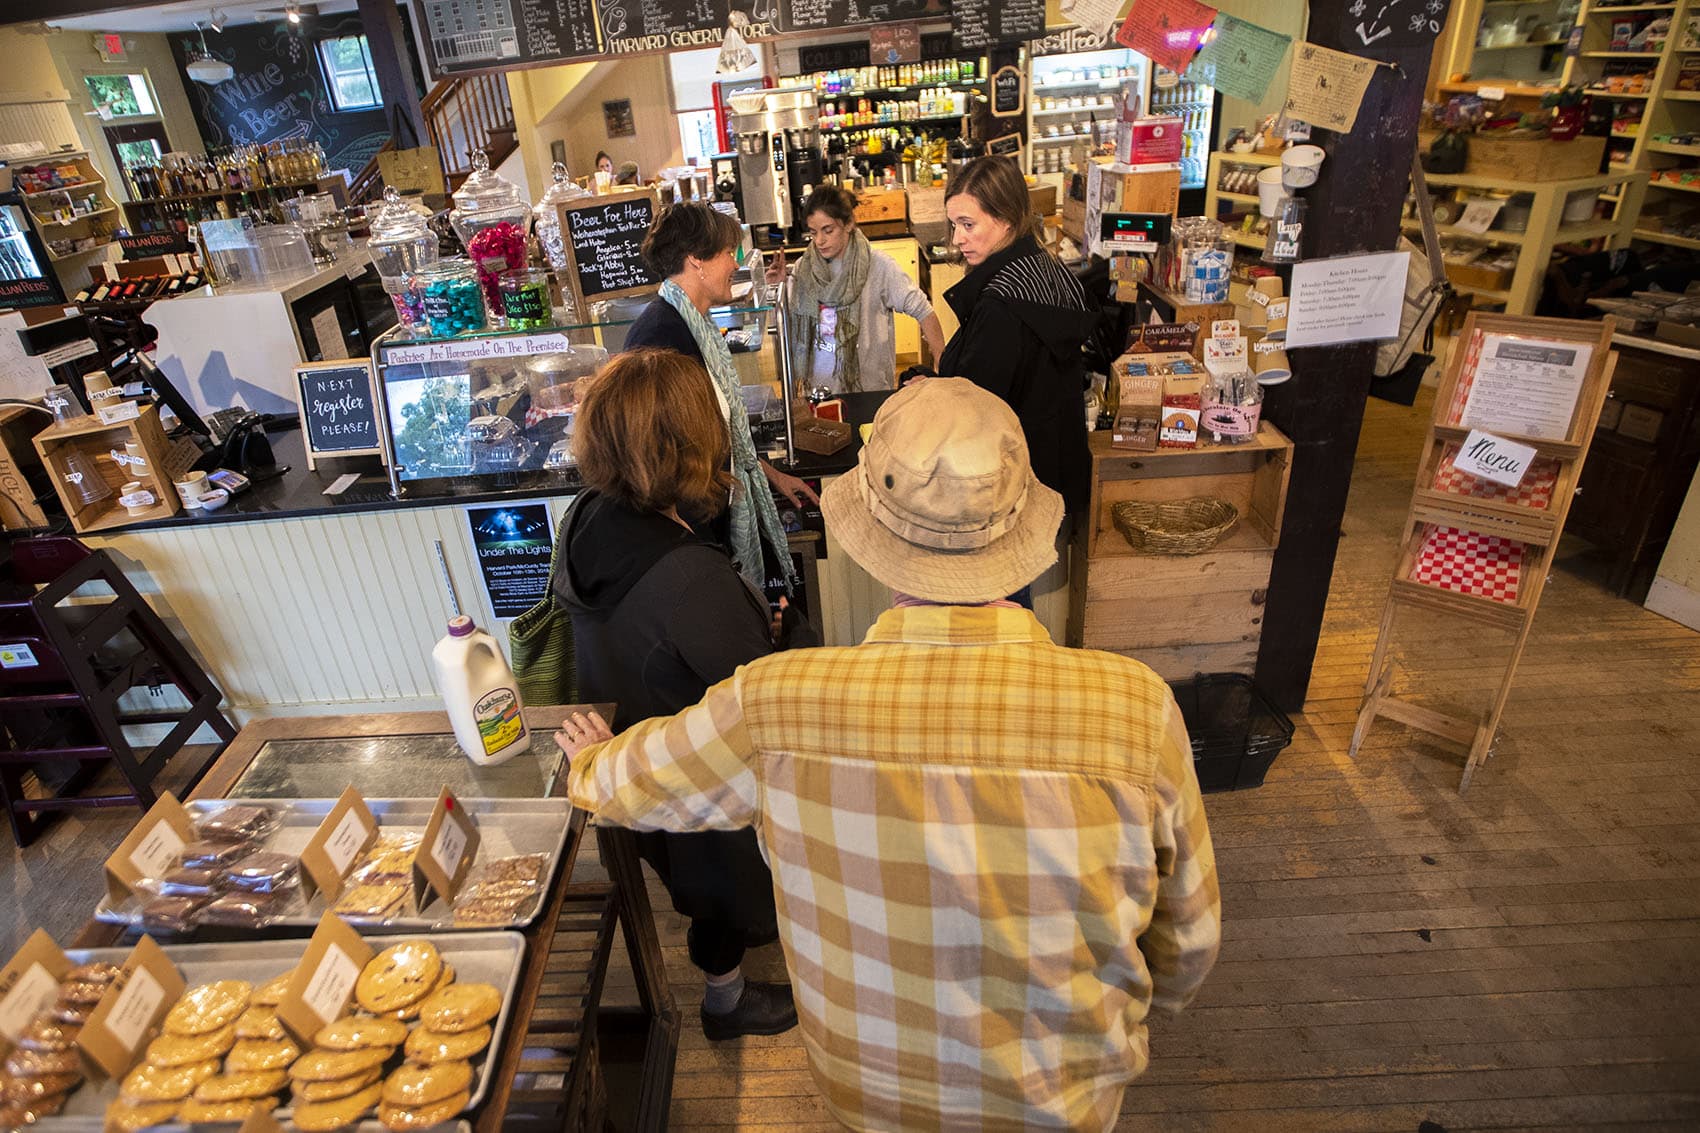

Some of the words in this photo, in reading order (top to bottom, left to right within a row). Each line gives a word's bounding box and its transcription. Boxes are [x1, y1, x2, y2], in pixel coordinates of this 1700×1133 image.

[610, 34, 668, 54] HARVARD
[671, 27, 724, 47] GENERAL
[738, 22, 772, 39] TORE
[214, 63, 284, 110] Wine
[239, 93, 300, 139] Beer
[570, 211, 601, 229] Beer
[603, 206, 622, 223] For
[624, 204, 648, 220] Here
[121, 239, 151, 249] ITALIAN
[1329, 269, 1350, 277] Kitchen
[21, 281, 49, 293] REDS
[1145, 326, 1186, 336] CARAMELS
[390, 350, 425, 365] Pastries
[430, 348, 444, 361] Are
[446, 345, 491, 360] Homemade
[493, 342, 505, 354] On
[508, 341, 523, 353] The
[526, 338, 567, 352] Premises
[312, 393, 364, 423] register
[1468, 438, 1520, 473] Menu
[480, 548, 506, 557] Under
[508, 546, 525, 555] The
[526, 545, 551, 556] Lights
